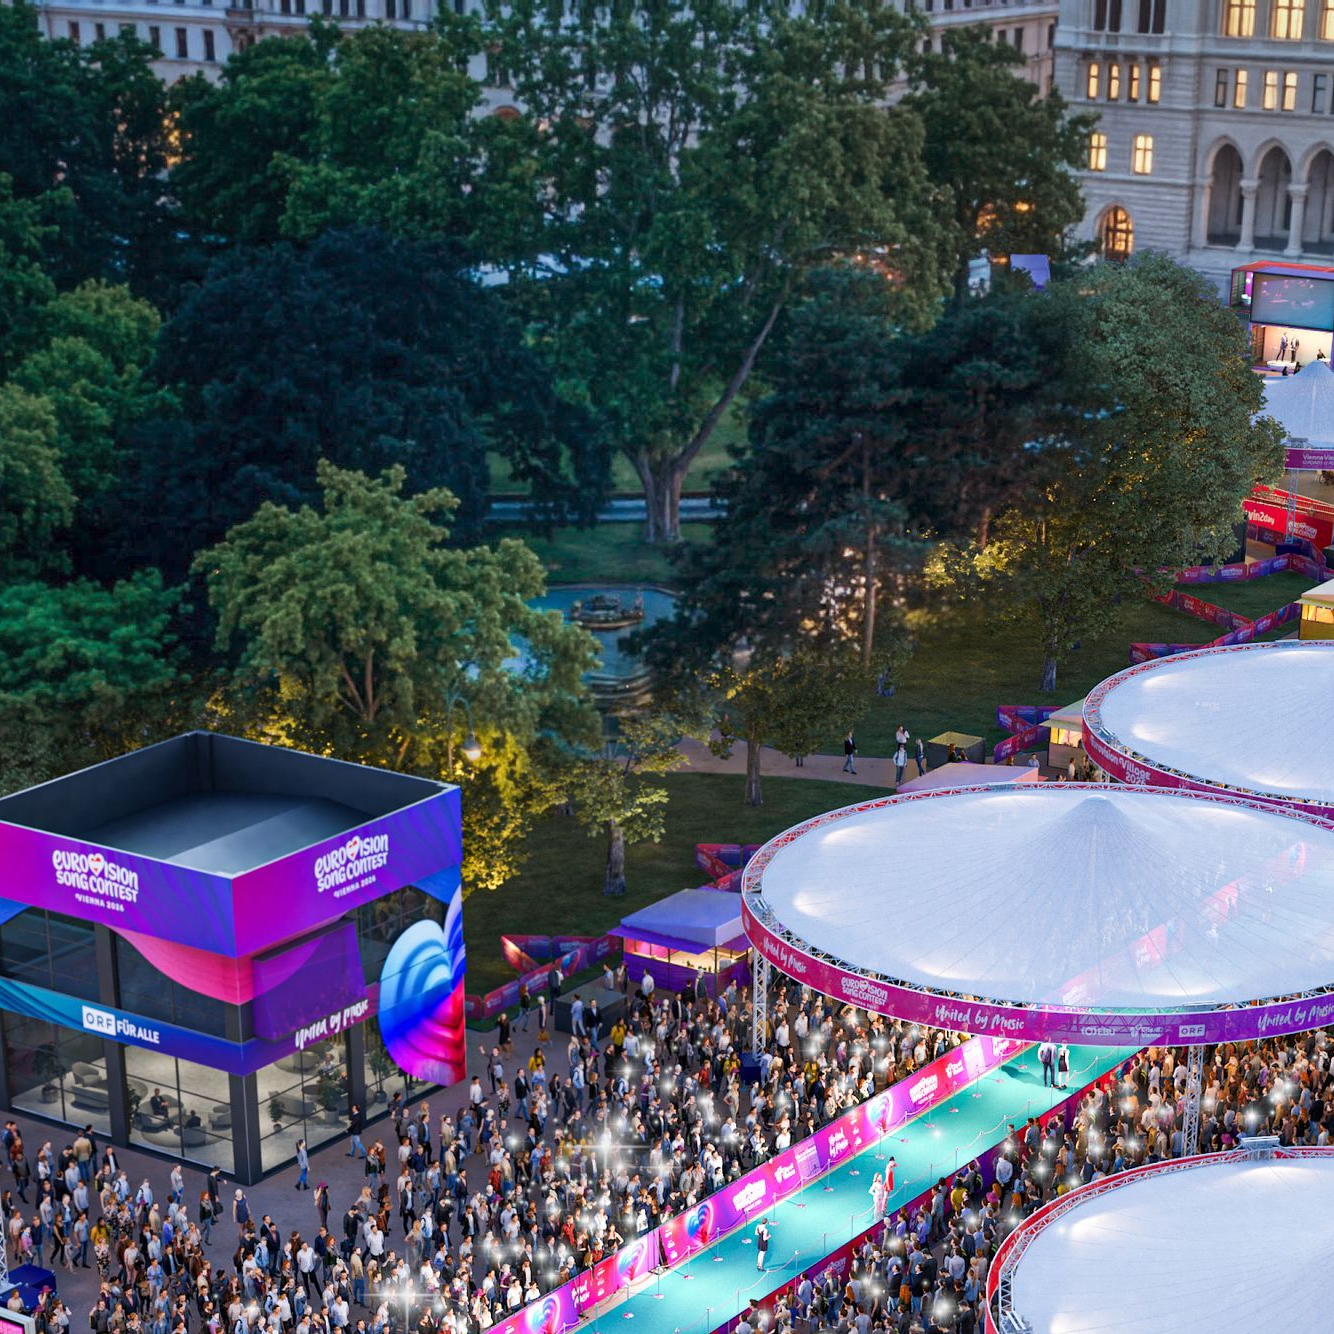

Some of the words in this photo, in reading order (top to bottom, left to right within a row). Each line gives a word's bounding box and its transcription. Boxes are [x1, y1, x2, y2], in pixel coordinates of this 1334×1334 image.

[52, 850, 139, 891] EUROVISION
[314, 834, 389, 879] EUROVISION
[56, 870, 89, 891] SONG
[89, 875, 138, 903] CONTEST
[317, 866, 347, 893] SONG
[346, 852, 388, 880] CONTEST
[75, 893, 105, 908] VIENNA
[333, 882, 360, 898] VIENNA
[86, 1012, 113, 1030] ORF
[117, 1018, 137, 1038] FÜR
[137, 1027, 161, 1045] ALLE
[935, 1005, 970, 1025] United
[975, 1011, 989, 1031] by
[991, 1014, 1025, 1032] Music
[1181, 1026, 1203, 1036] ORF
[1258, 1013, 1292, 1032] United
[1295, 1007, 1306, 1025] by
[1308, 1003, 1334, 1022] Music
